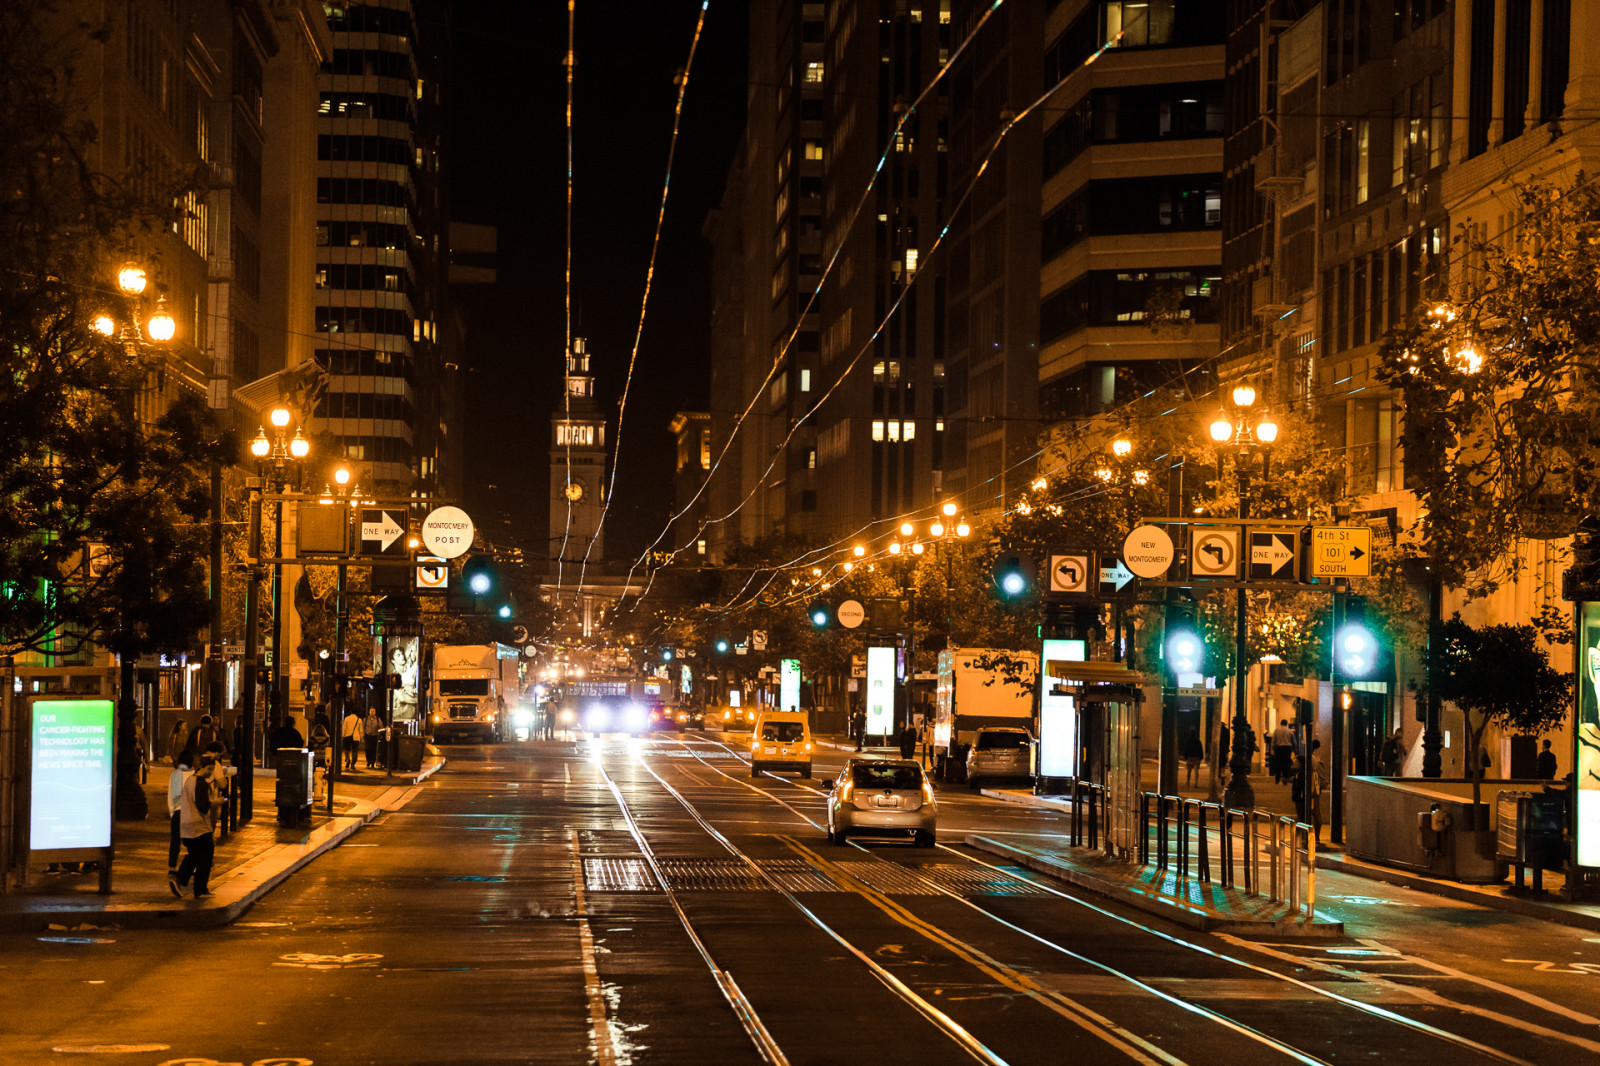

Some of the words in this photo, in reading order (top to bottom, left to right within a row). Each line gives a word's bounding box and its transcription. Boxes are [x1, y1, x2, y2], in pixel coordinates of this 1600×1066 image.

[363, 527, 379, 535] ONE
[1316, 531, 1334, 540] 4th
[1339, 531, 1350, 541] St
[1253, 551, 1269, 559] ONE
[1326, 548, 1340, 558] 101
[1128, 555, 1168, 563] MONTGOMERY
[1319, 565, 1347, 573] SOUTH
[39, 715, 56, 723] OUR
[39, 726, 105, 734] CANCER-FIGHTING
[39, 737, 88, 746] TECHNOLOGY
[90, 737, 105, 745] HAS
[39, 749, 58, 757] BEEN
[60, 749, 89, 757] MAKING
[90, 748, 104, 756] THE
[39, 760, 61, 769] NEWS
[62, 760, 83, 768] SINCE
